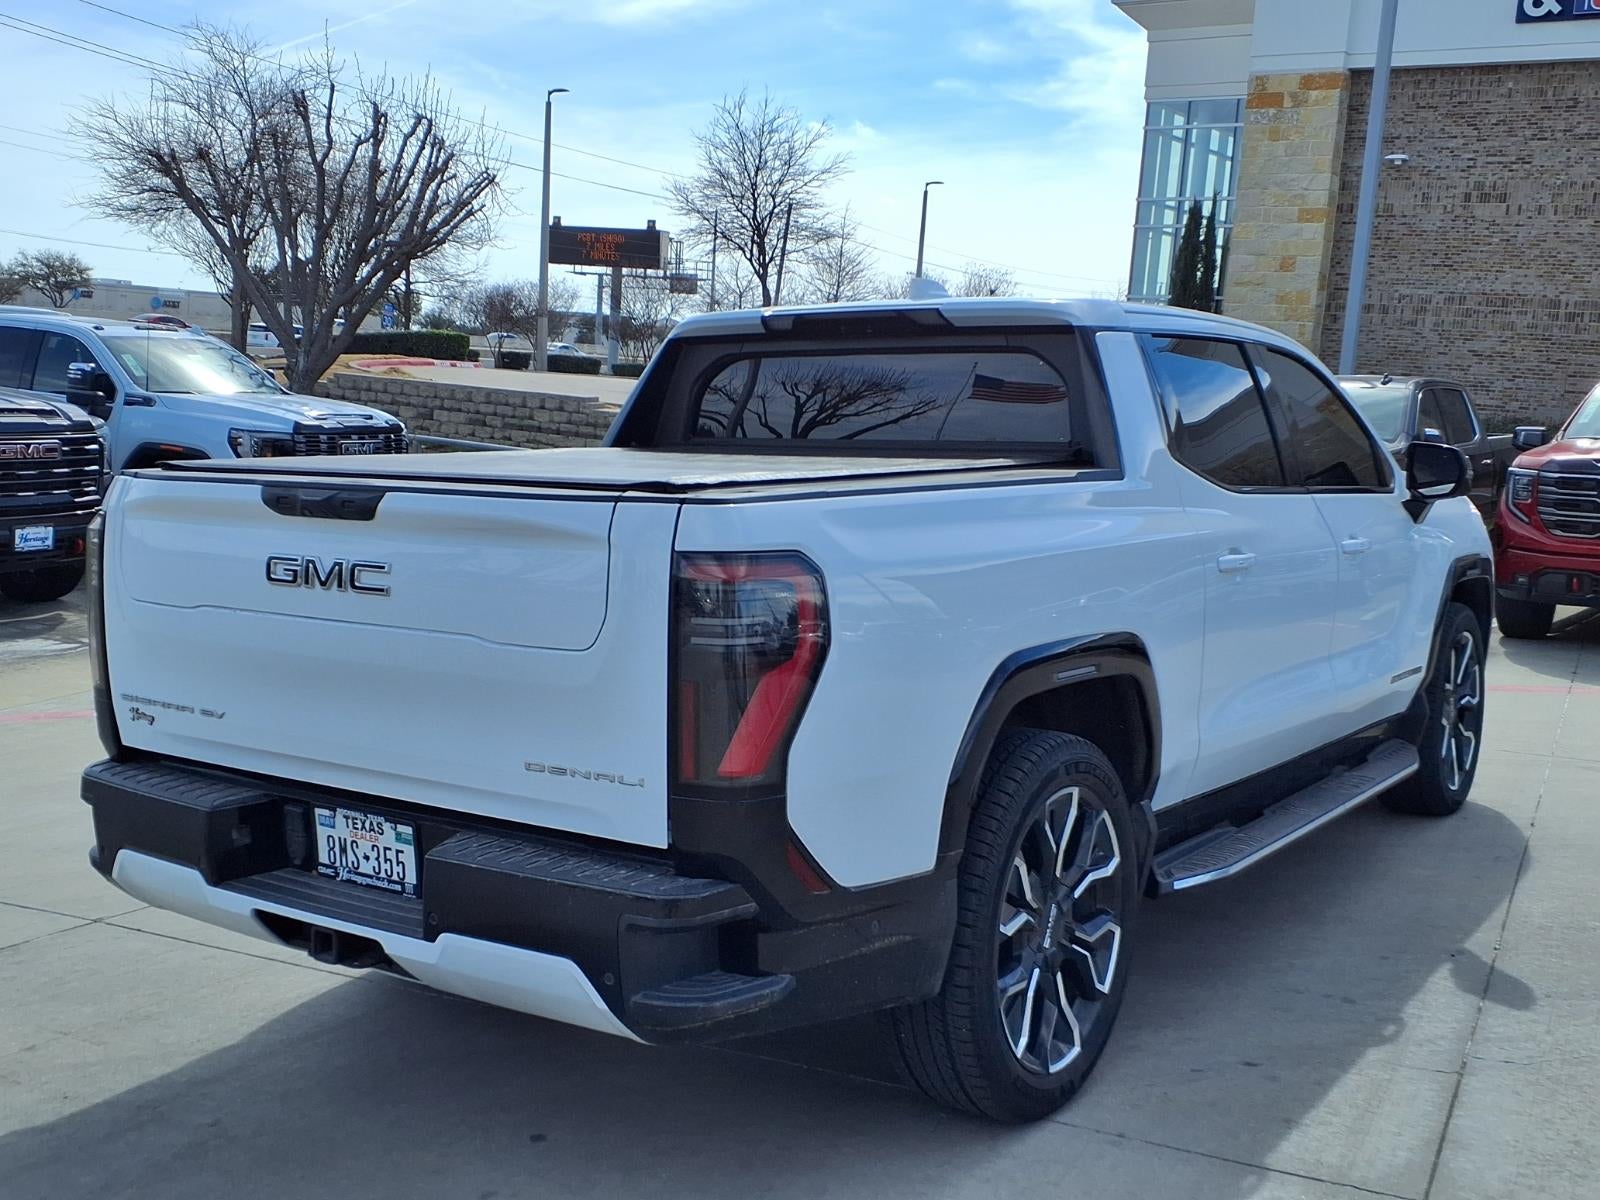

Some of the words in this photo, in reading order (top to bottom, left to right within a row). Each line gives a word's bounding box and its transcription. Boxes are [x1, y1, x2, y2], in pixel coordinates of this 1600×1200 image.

[594, 242, 615, 251] MILES
[590, 251, 620, 261] MINUTES
[0, 443, 60, 459] GMC
[341, 443, 383, 455] GMC
[16, 533, 49, 548] Heritage
[266, 553, 392, 597] GMC
[524, 762, 645, 788] DENALI
[343, 814, 385, 836] TEXAS
[349, 830, 379, 843] DEALER
